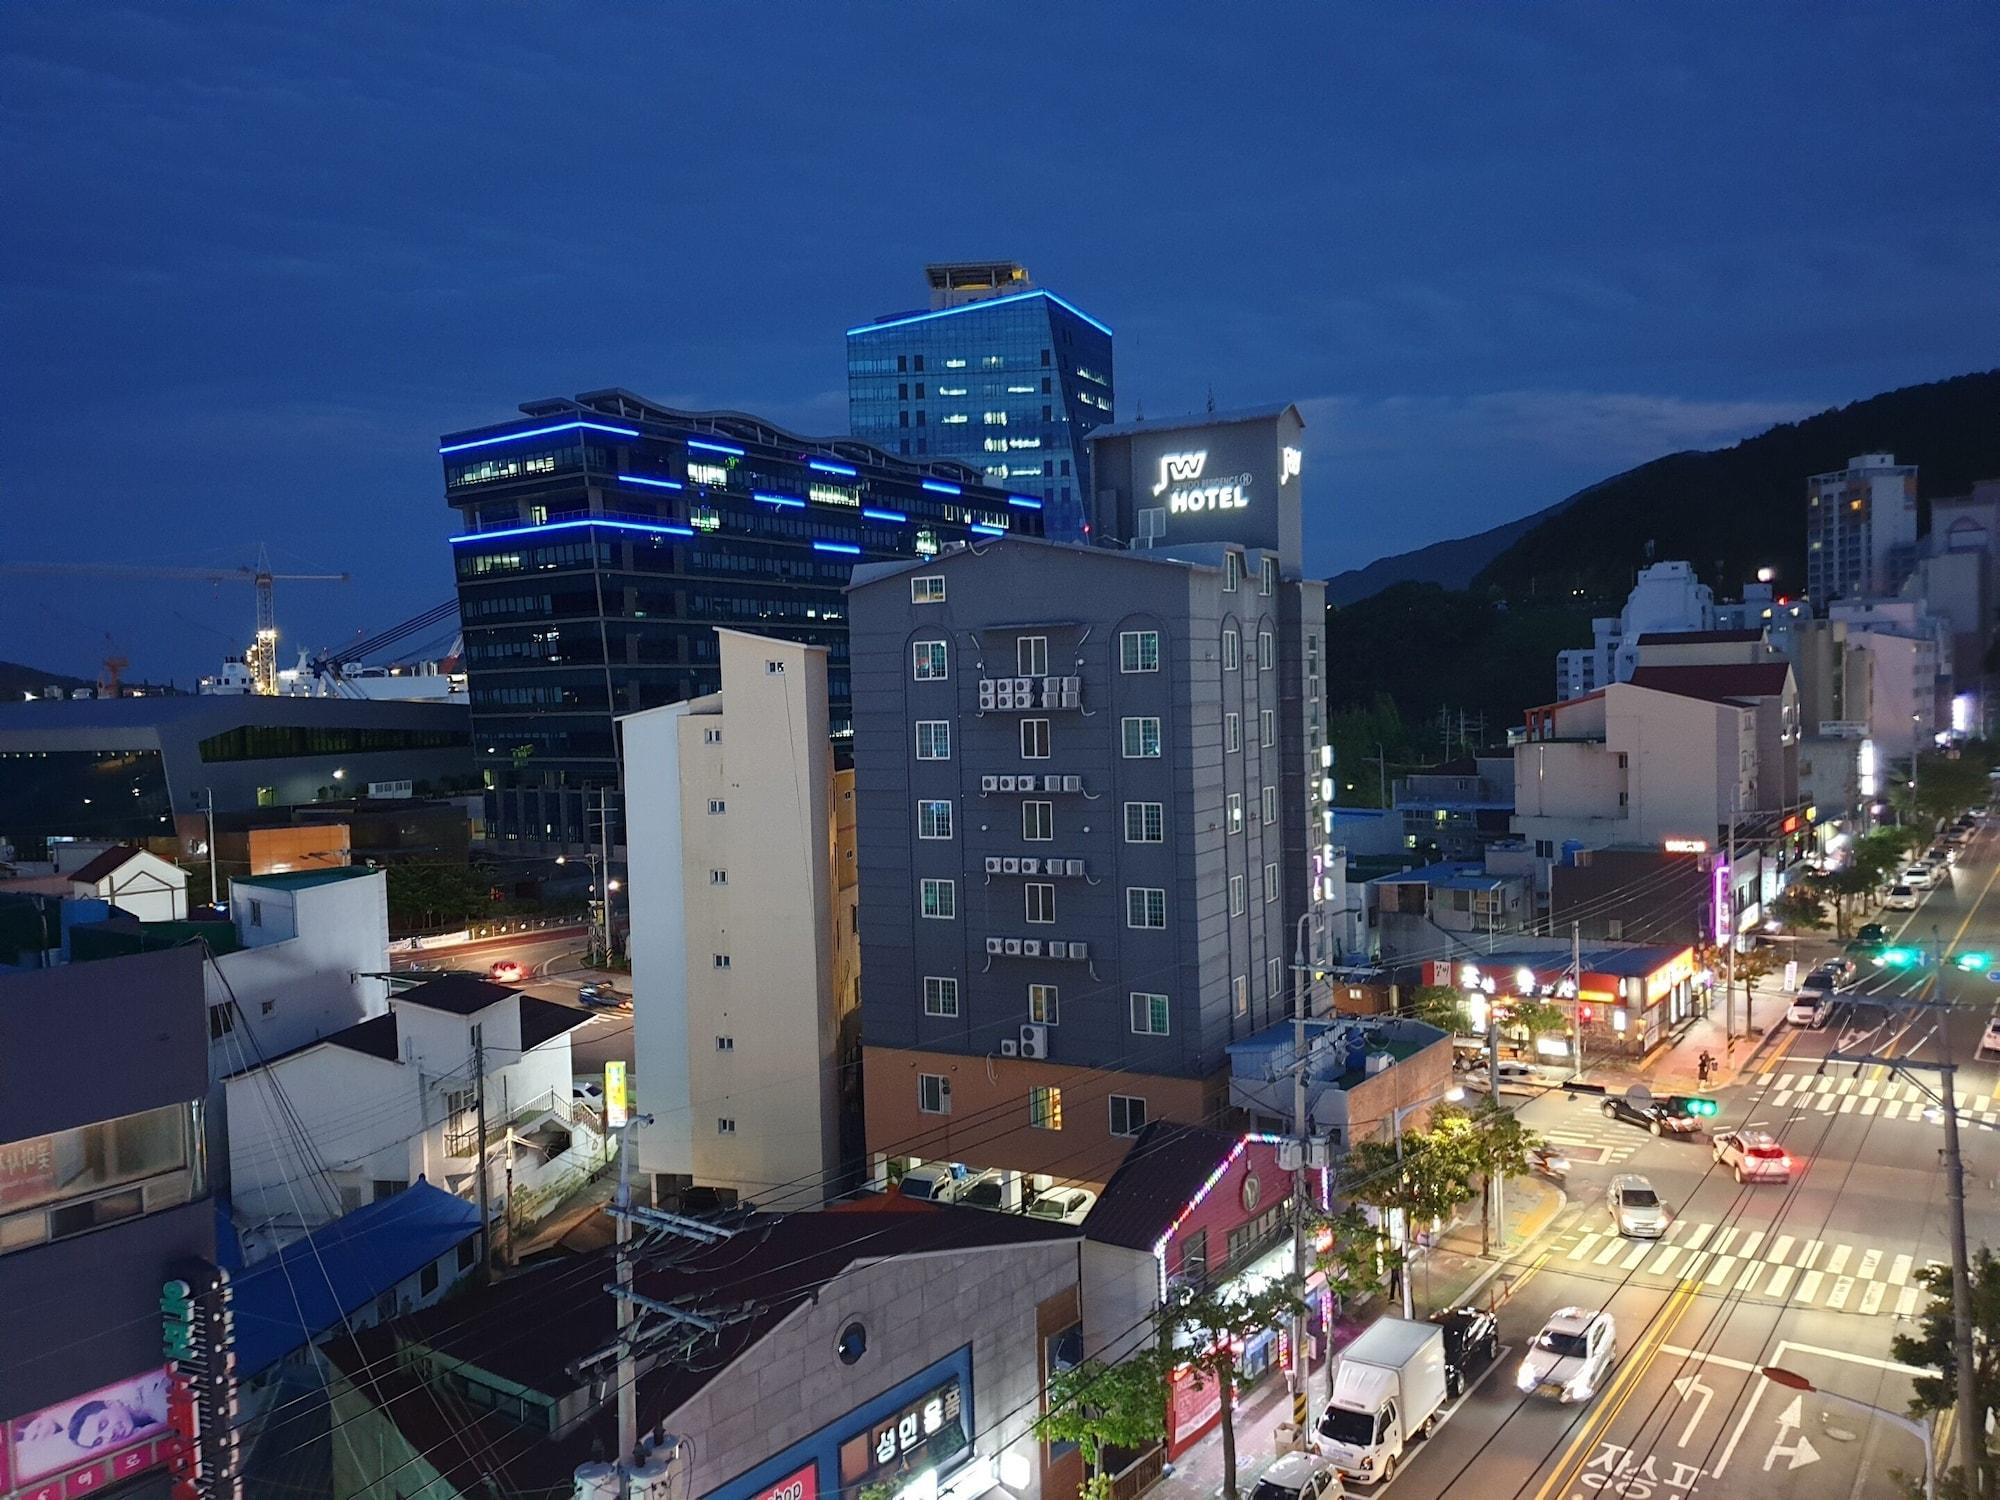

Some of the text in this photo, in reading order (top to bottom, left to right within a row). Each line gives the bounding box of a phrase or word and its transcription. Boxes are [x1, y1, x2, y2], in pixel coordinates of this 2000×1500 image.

[1153, 450, 1208, 496] JW
[1171, 485, 1249, 514] HOTEL
[1321, 745, 1335, 900] HOTEL
[876, 1388, 961, 1464] 성인용품
[1581, 1442, 1708, 1500] 장승포
